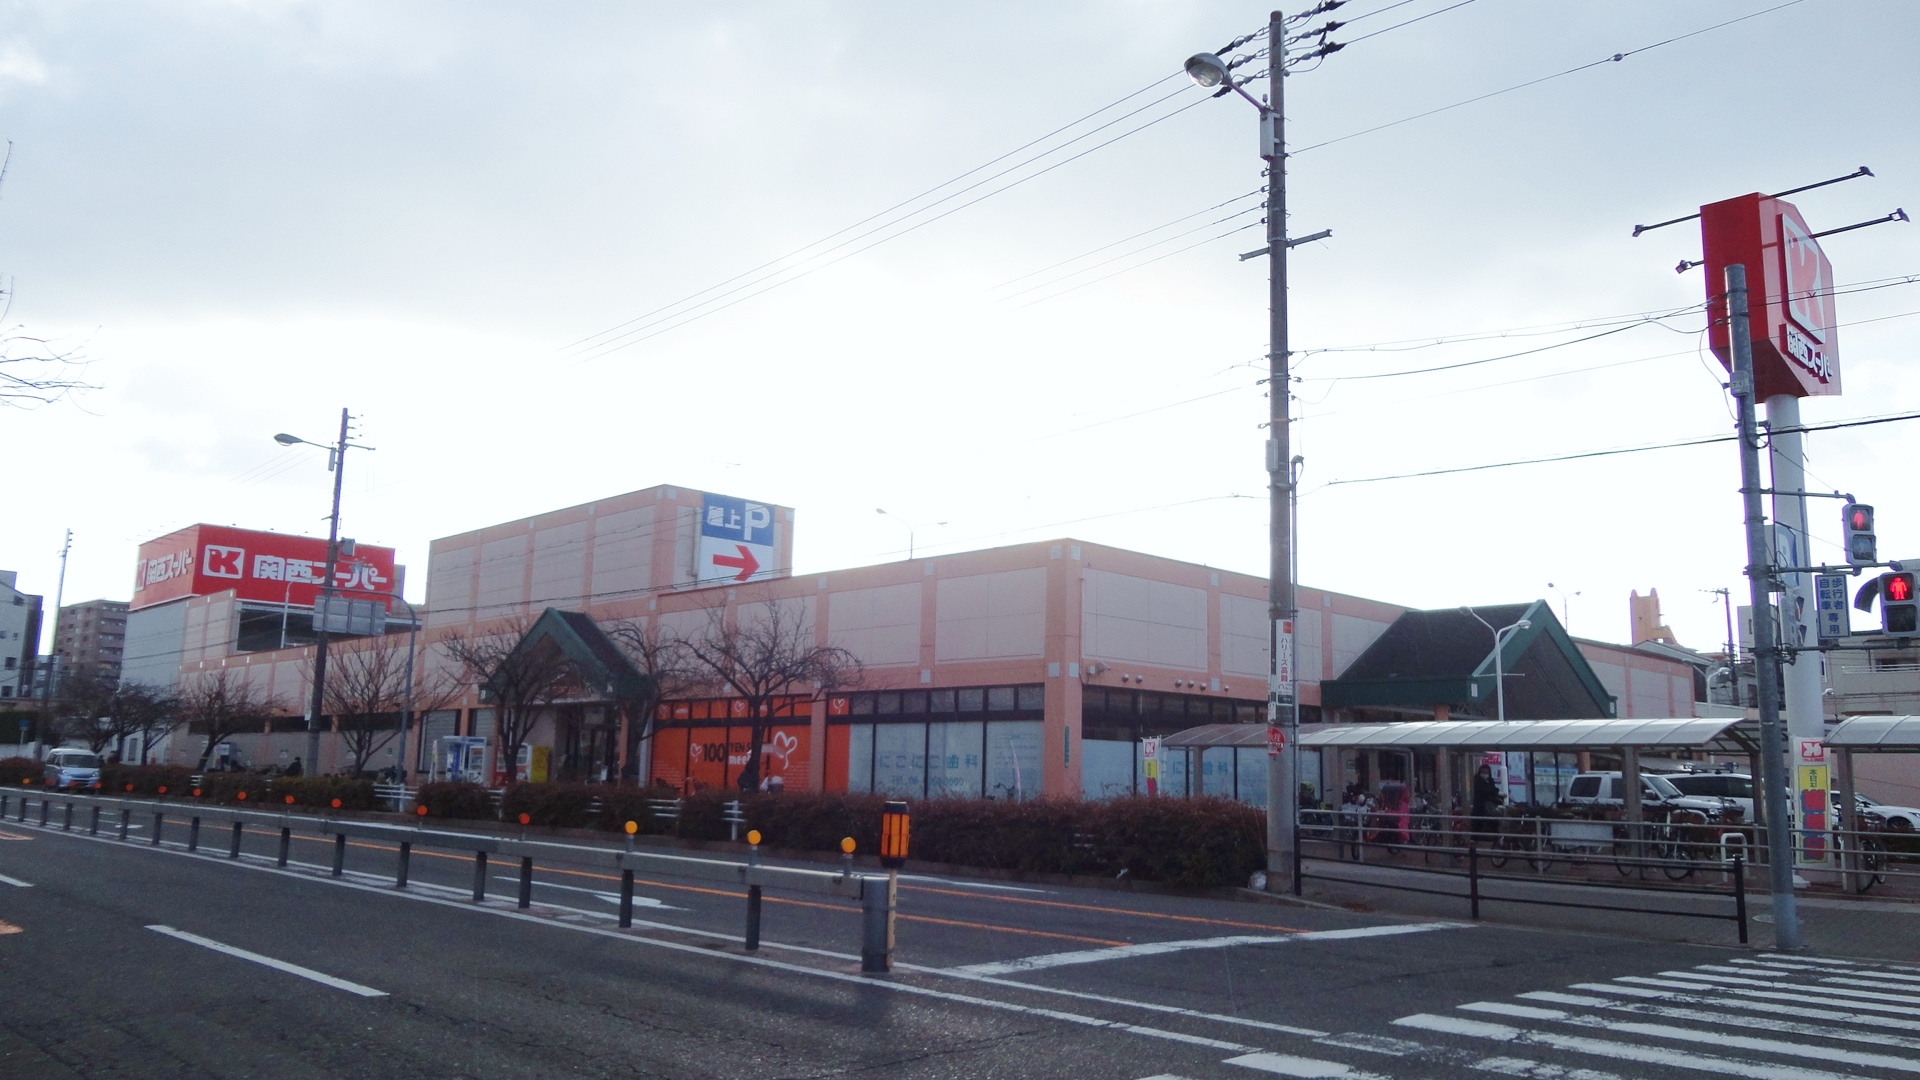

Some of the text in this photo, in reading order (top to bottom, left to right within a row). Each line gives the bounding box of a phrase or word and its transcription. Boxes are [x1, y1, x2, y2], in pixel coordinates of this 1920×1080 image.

[147, 548, 194, 586] 関西スーパー
[252, 556, 387, 590] 関西スーパー
[1828, 612, 1840, 634] 専用
[703, 743, 725, 763] 100
[878, 753, 979, 770] にこにこ歯科
